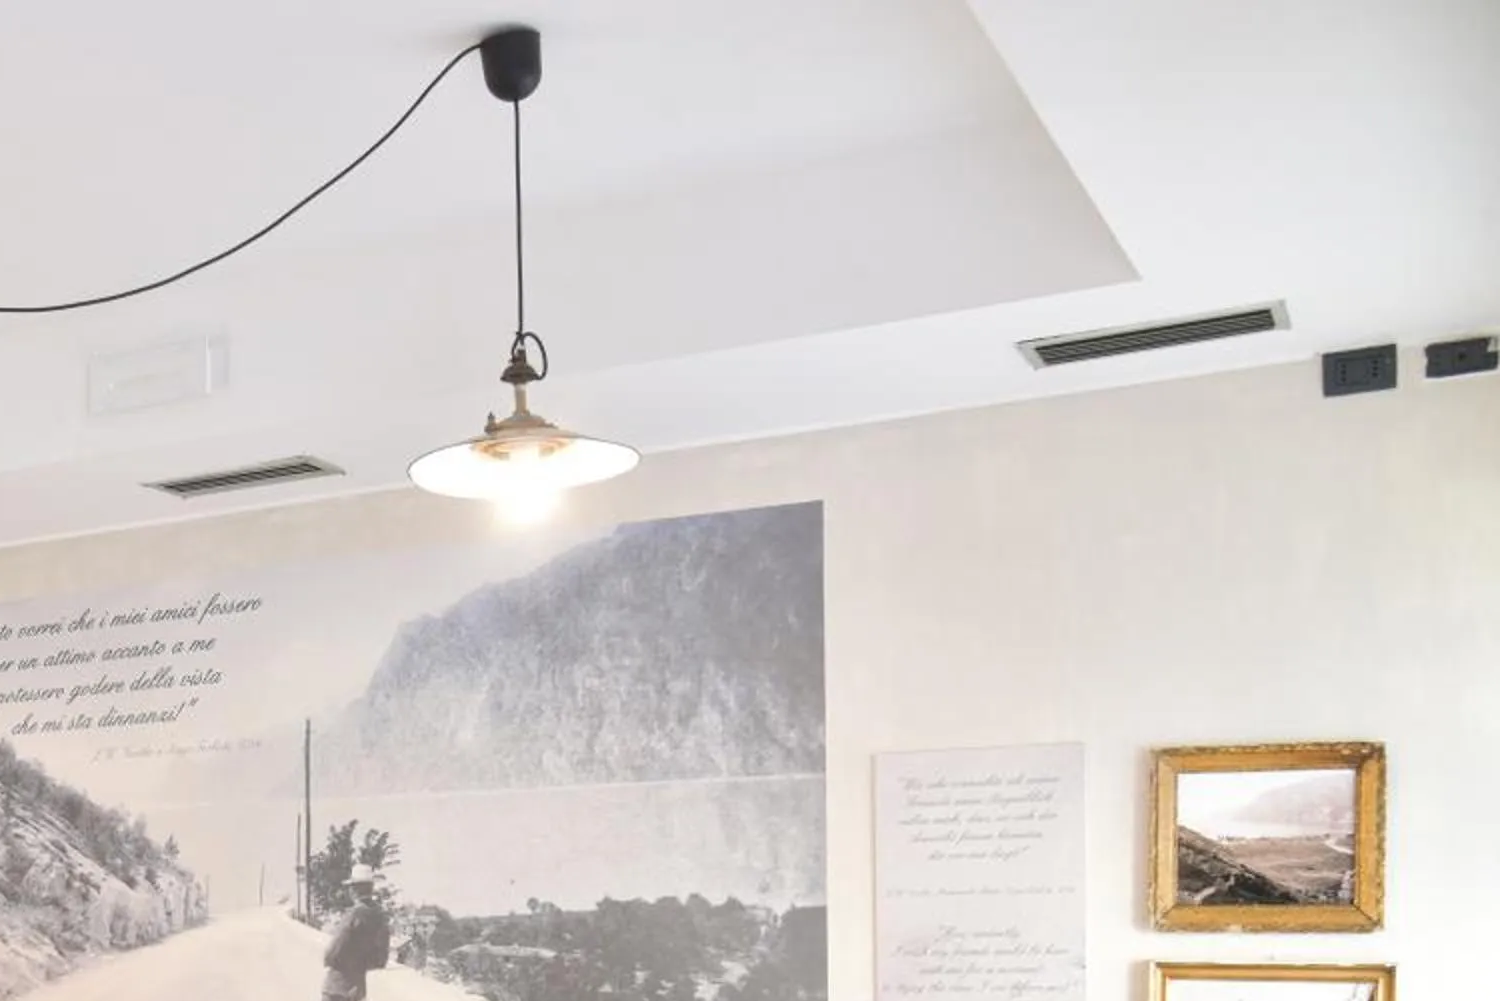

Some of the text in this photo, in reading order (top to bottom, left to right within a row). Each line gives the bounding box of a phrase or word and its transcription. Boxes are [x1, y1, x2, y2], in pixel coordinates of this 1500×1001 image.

[67, 607, 95, 632] che
[99, 610, 109, 629] i
[110, 607, 150, 628] miei
[151, 600, 201, 623] amici
[198, 592, 262, 625] fossero
[18, 656, 38, 671] un
[43, 648, 96, 669] attimo
[102, 640, 167, 662] accanto
[171, 642, 184, 655] a
[189, 638, 218, 652] me
[65, 674, 125, 705] godere
[129, 665, 175, 691] della
[179, 667, 222, 687] vista
[11, 712, 38, 735] che
[41, 714, 62, 732] mi
[66, 713, 93, 731] sta
